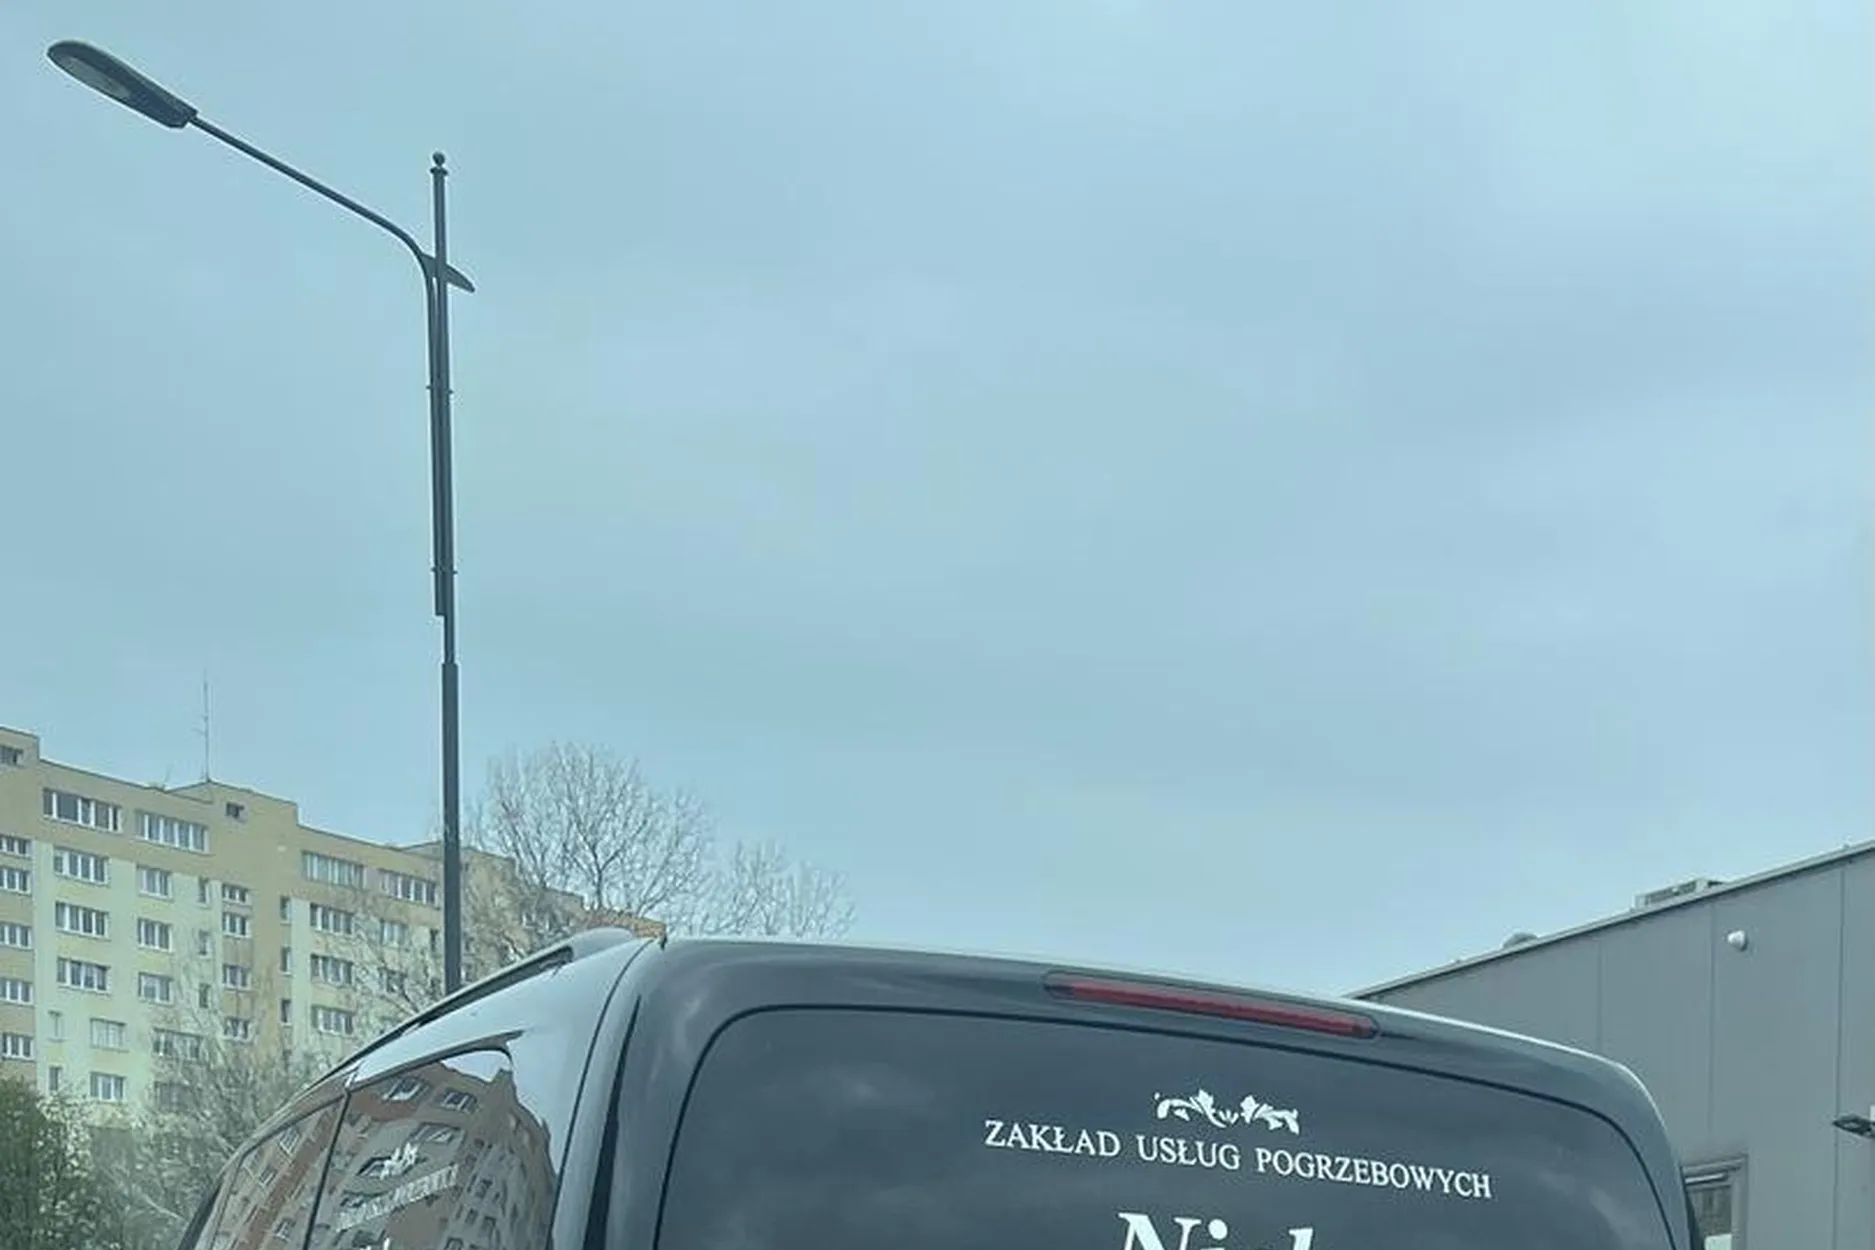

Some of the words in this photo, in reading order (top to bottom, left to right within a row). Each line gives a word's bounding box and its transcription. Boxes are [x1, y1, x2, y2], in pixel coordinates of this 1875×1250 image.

[984, 1119, 1121, 1157] ZAKŁAD
[1136, 1134, 1241, 1170] USŁUG
[1256, 1147, 1492, 1199] POGRZEBOWYCH
